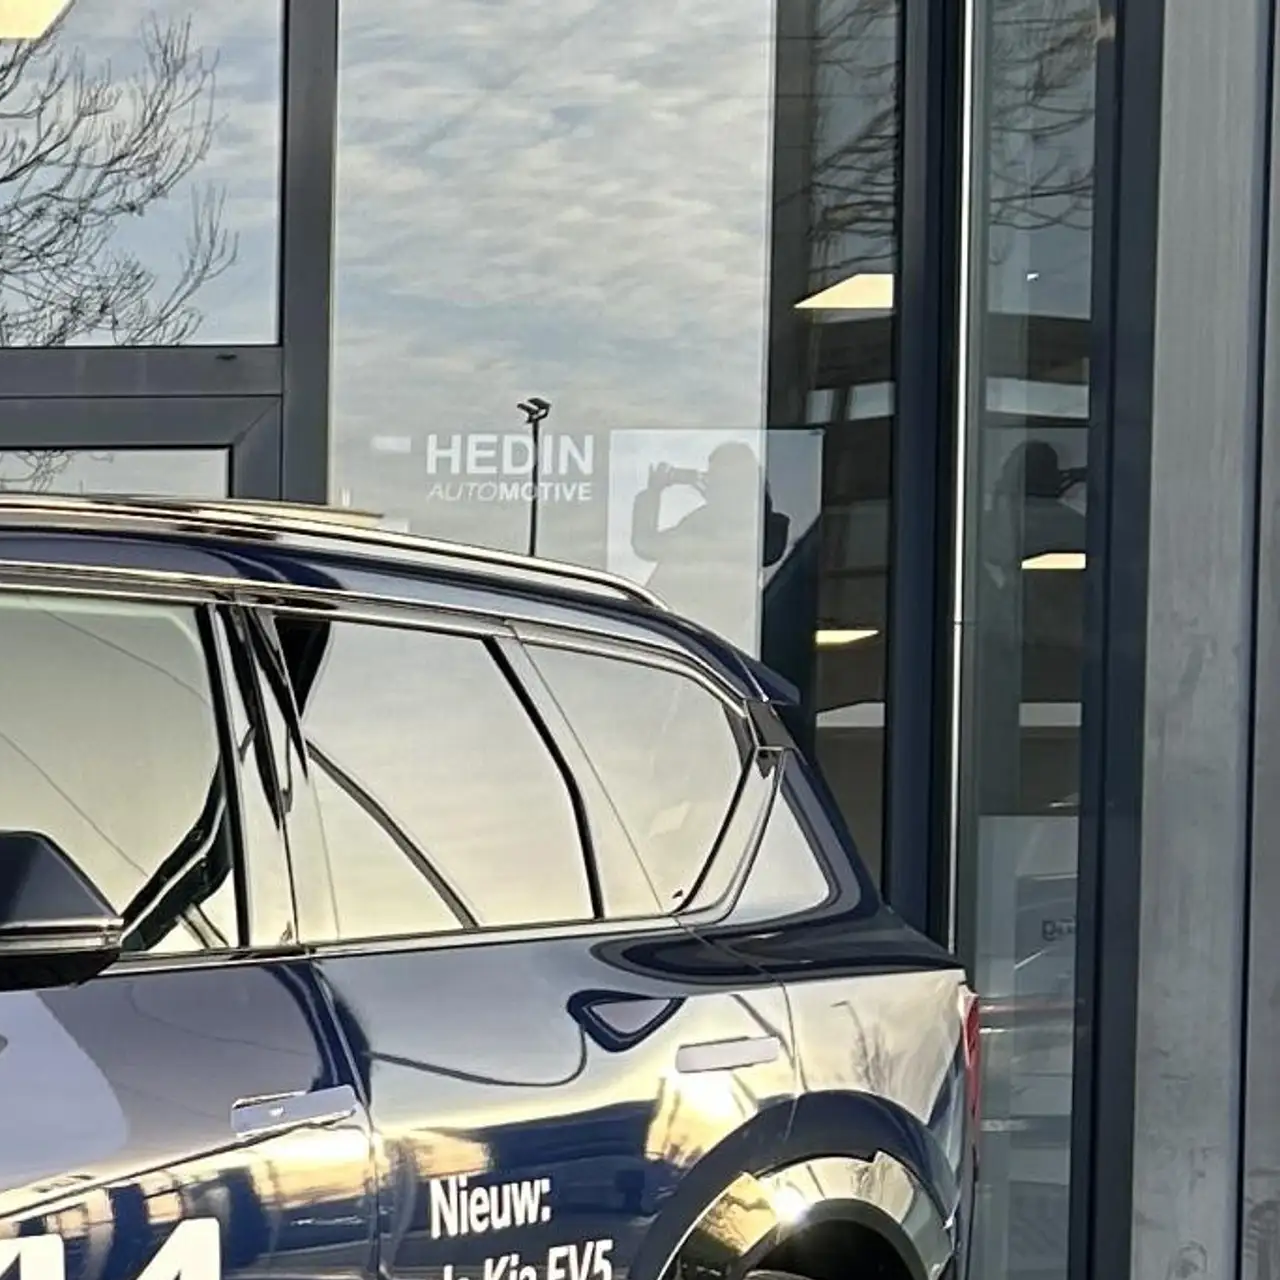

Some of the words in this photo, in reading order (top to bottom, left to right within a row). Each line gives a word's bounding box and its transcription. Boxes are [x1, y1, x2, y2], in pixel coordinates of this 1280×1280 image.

[426, 434, 594, 475] HEDIN
[427, 481, 593, 502] AUTOMOTIVE
[428, 1174, 552, 1238] Nieuw:
